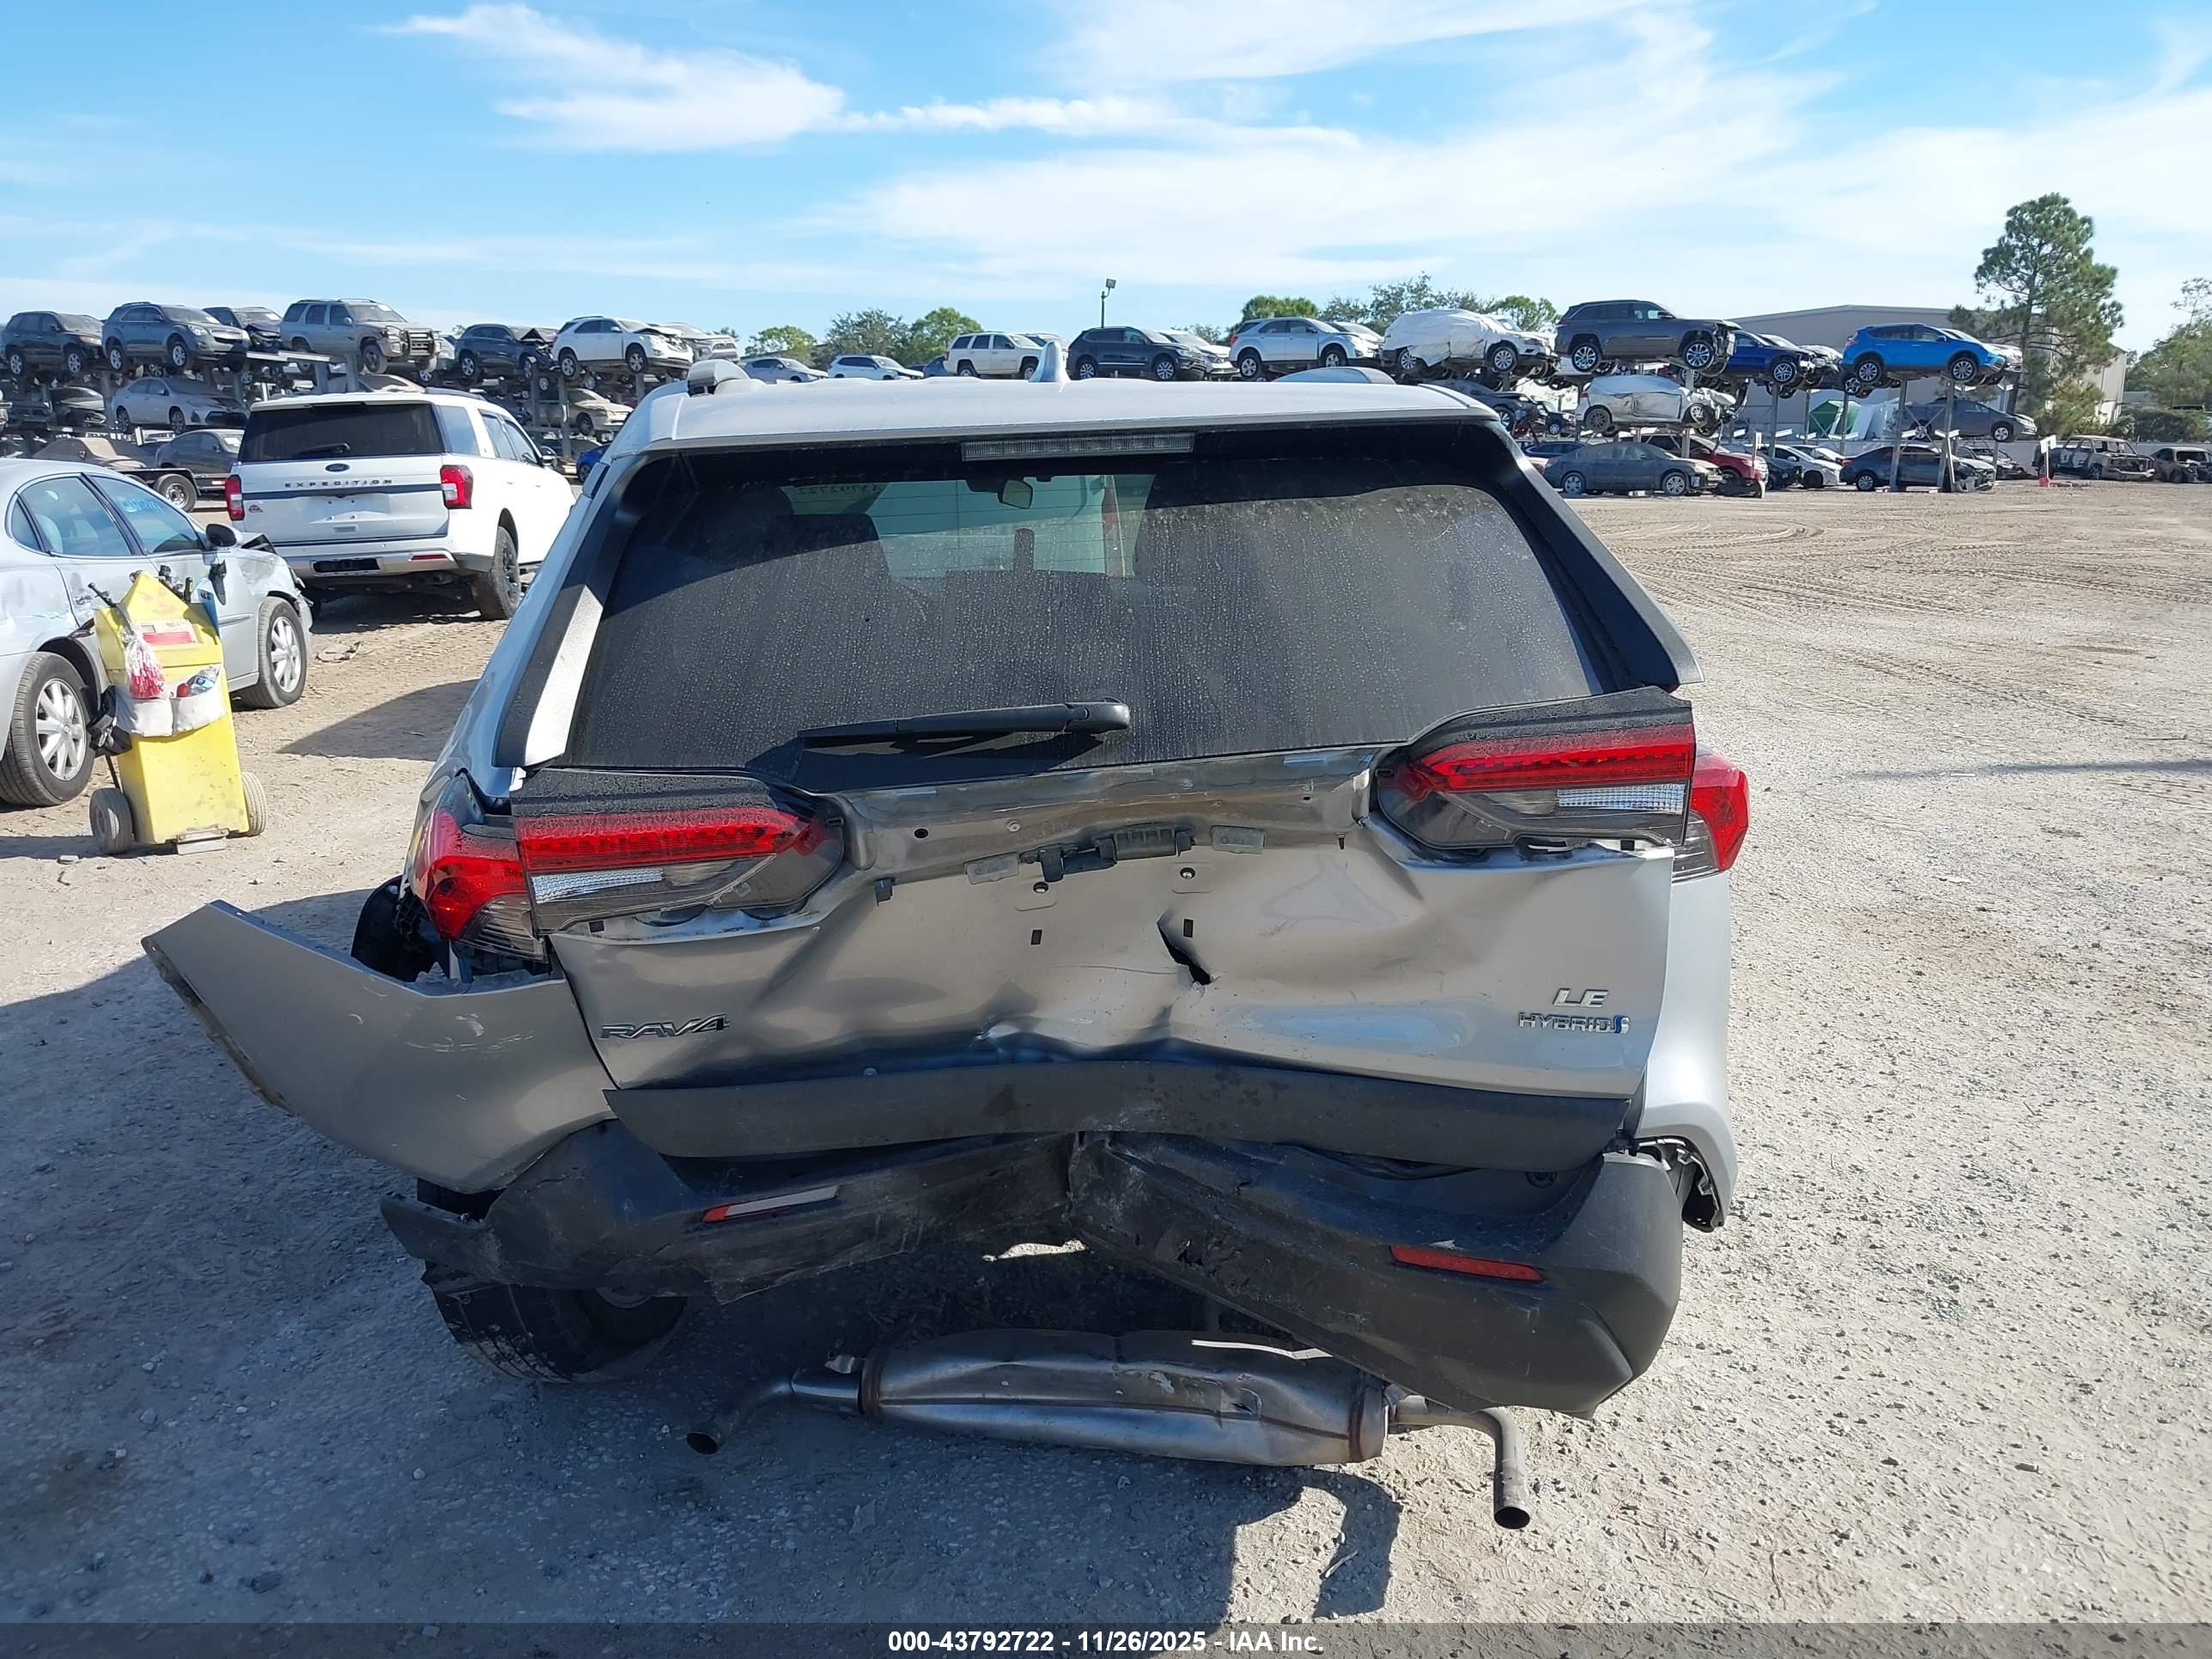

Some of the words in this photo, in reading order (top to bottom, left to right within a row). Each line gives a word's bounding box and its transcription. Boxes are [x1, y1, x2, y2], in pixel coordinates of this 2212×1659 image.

[284, 479, 392, 488] EXPEDITION
[1552, 988, 1608, 1008] LE
[600, 1013, 730, 1039] RAV4
[1518, 1012, 1614, 1033] HYBRID
